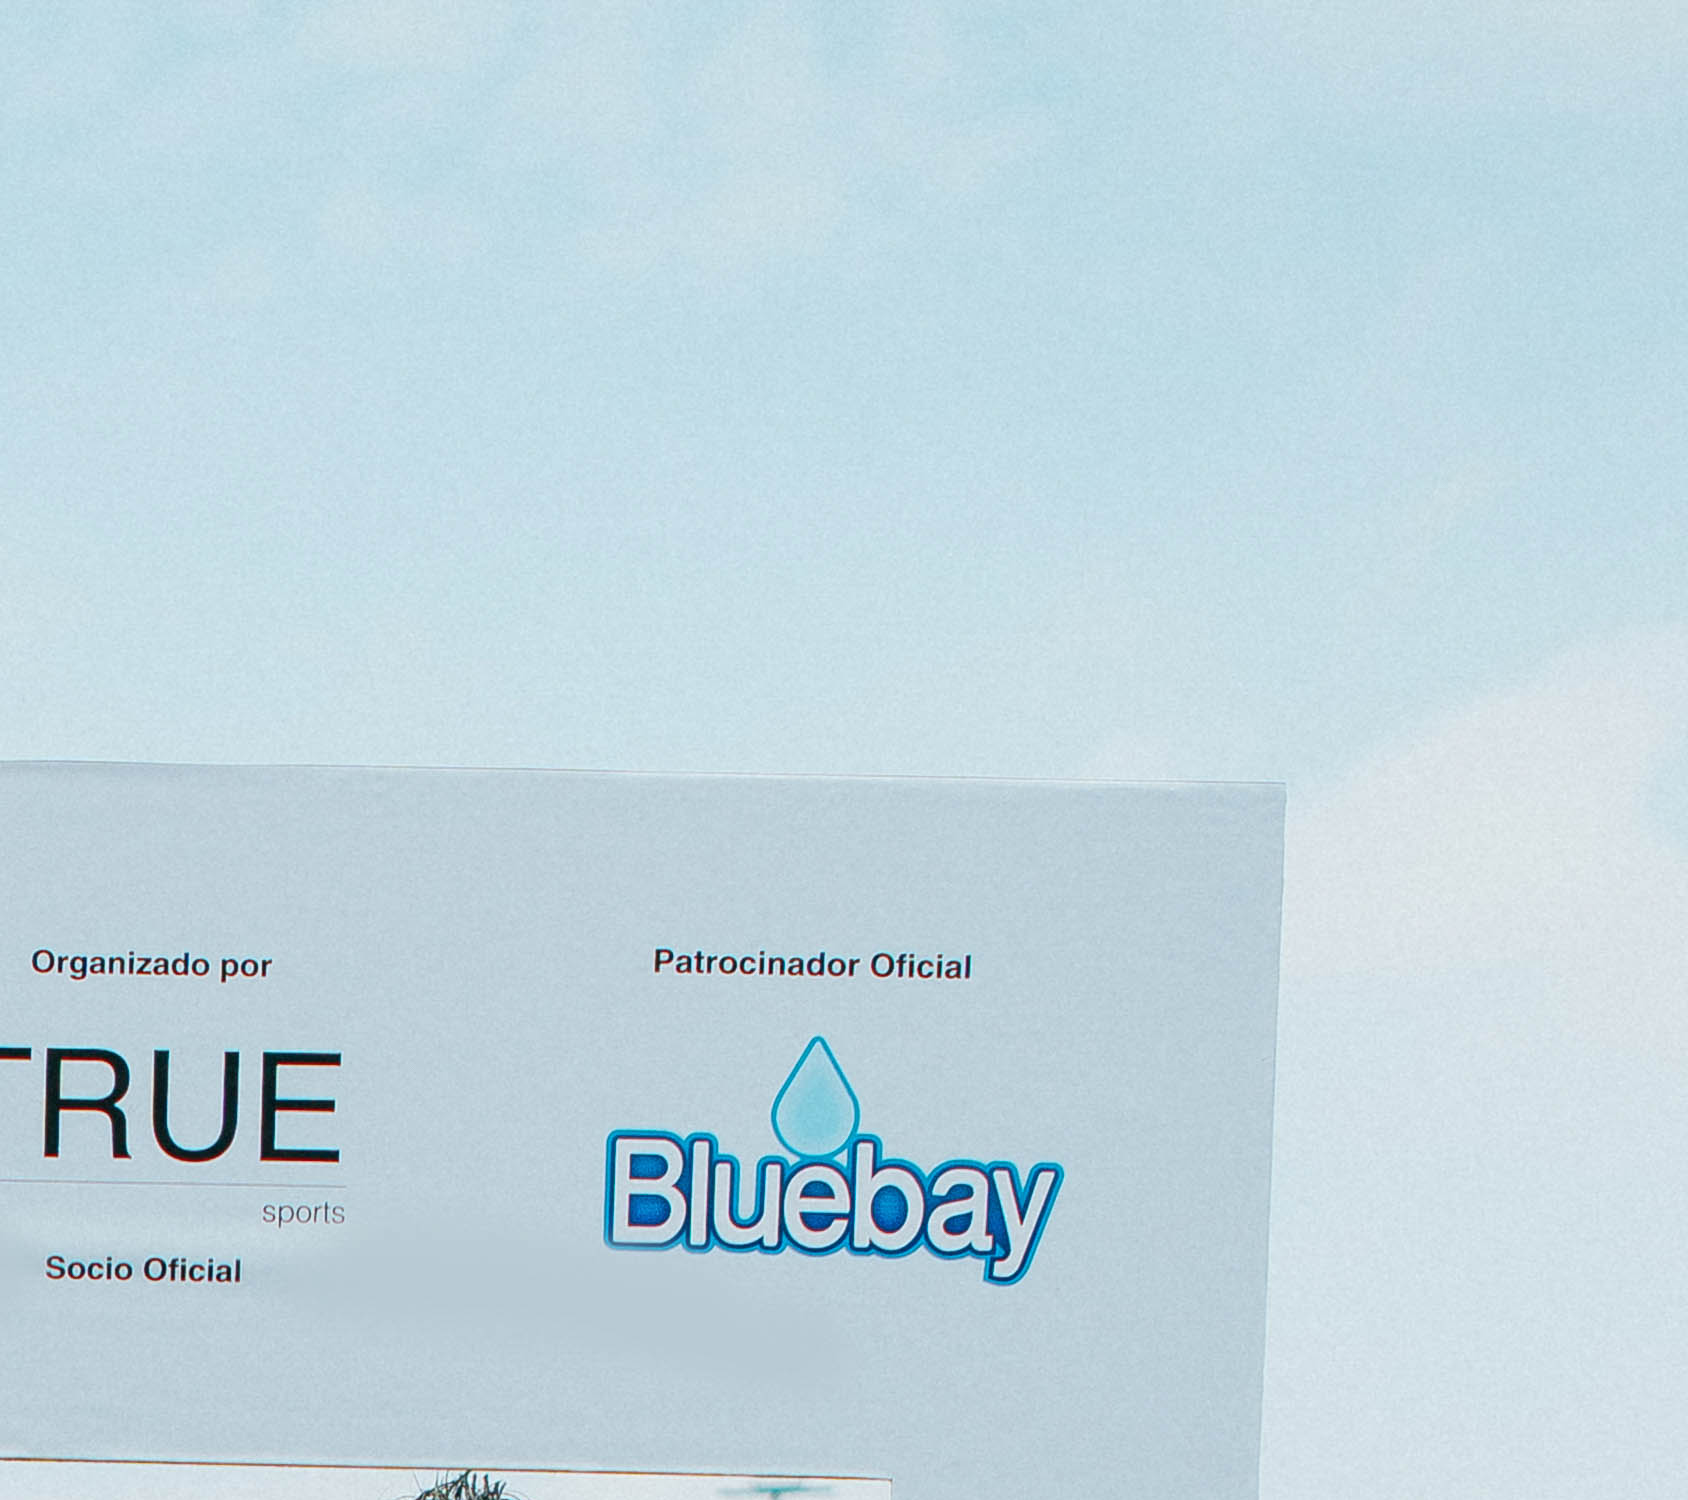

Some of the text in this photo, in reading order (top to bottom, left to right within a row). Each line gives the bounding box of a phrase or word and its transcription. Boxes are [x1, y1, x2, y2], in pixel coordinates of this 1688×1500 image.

[32, 950, 274, 984] Organizado por
[655, 949, 973, 981] Patrocinador Oficial
[262, 1201, 346, 1230] sports
[605, 1131, 1065, 1287] Bluebay
[46, 1256, 242, 1284] Socio Oficial
